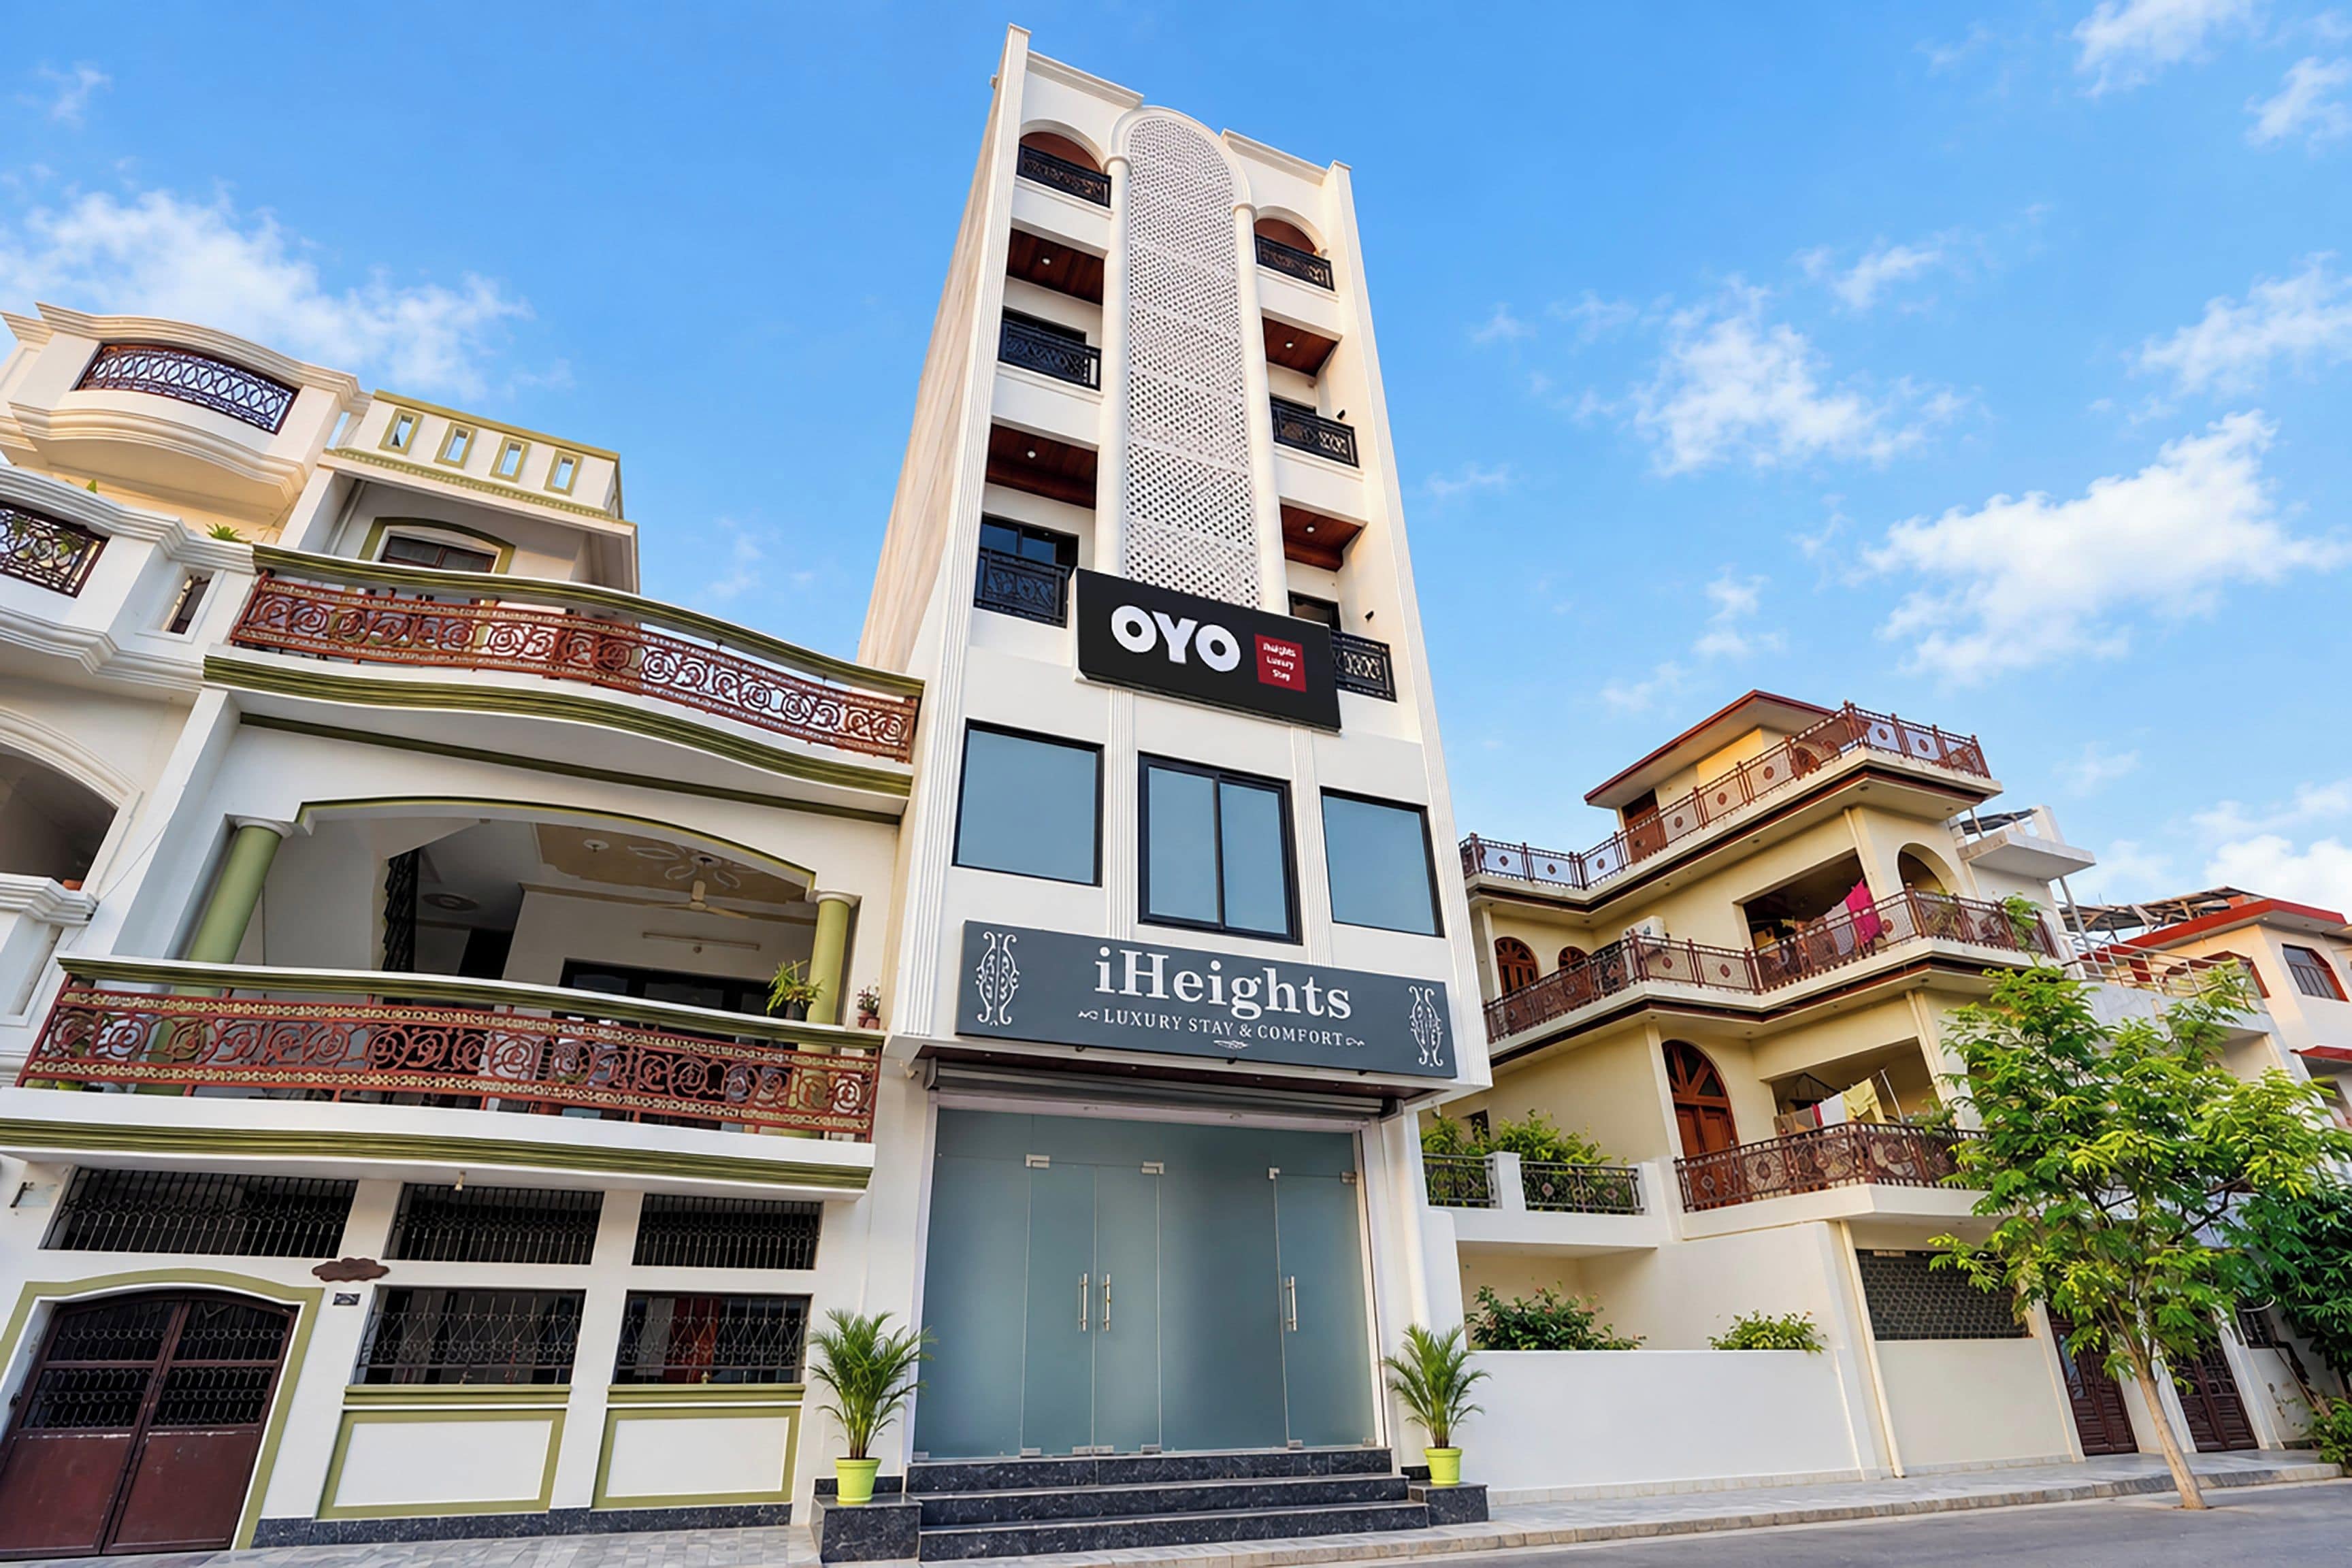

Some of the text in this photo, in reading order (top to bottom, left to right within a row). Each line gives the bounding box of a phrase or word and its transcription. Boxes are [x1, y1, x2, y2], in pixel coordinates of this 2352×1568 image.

[1111, 606, 1240, 672] OYO
[1094, 946, 1352, 1019] iHeights
[1104, 1008, 1343, 1046] LUXURY STAY & COMFORT
